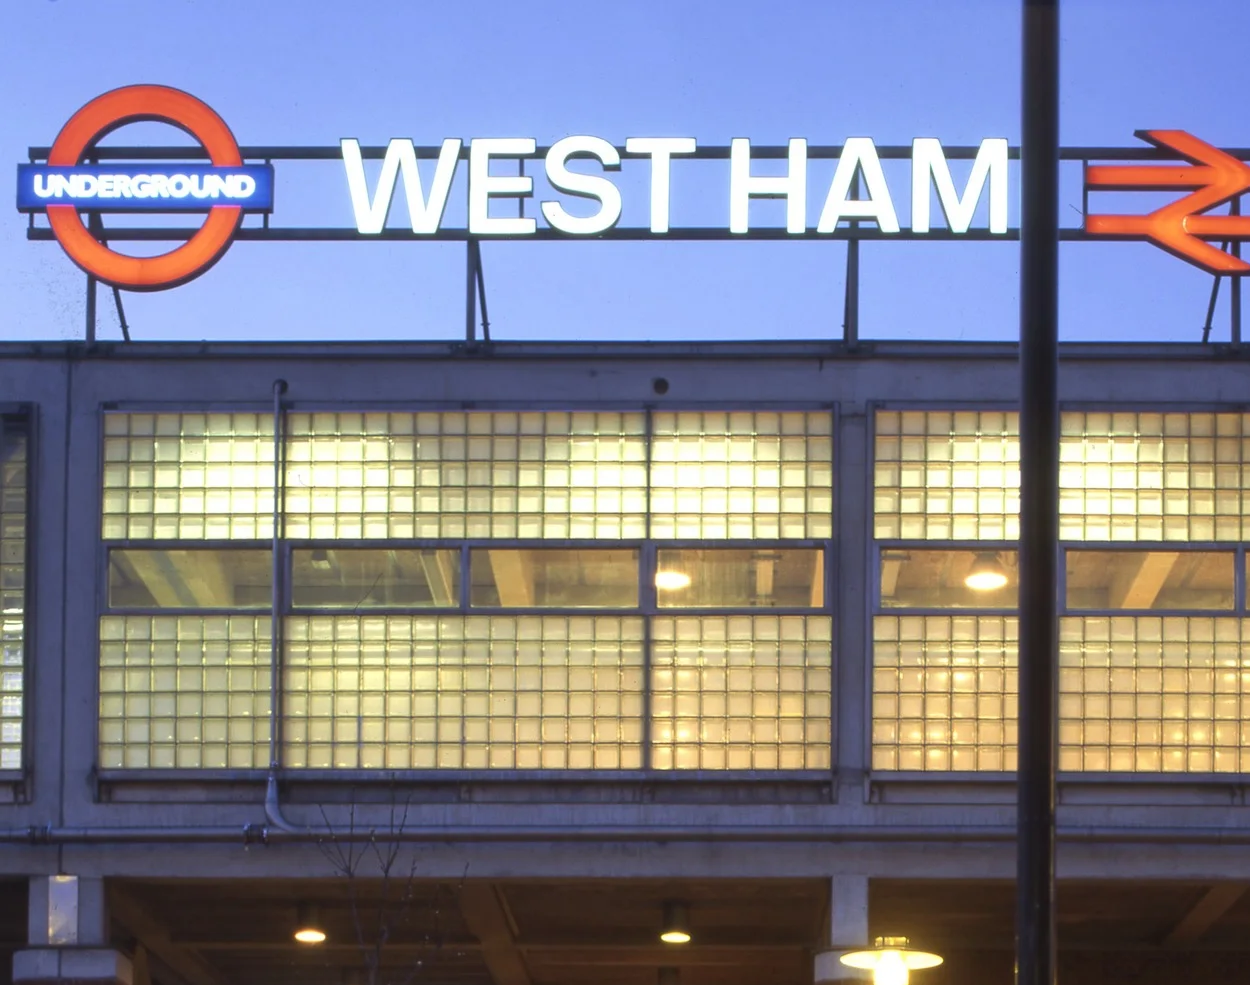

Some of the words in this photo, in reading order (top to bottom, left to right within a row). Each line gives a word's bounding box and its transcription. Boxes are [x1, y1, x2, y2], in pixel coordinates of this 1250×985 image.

[33, 173, 257, 199] UNDERGROUND
[339, 135, 697, 236] WEST
[729, 136, 1009, 235] HAM
